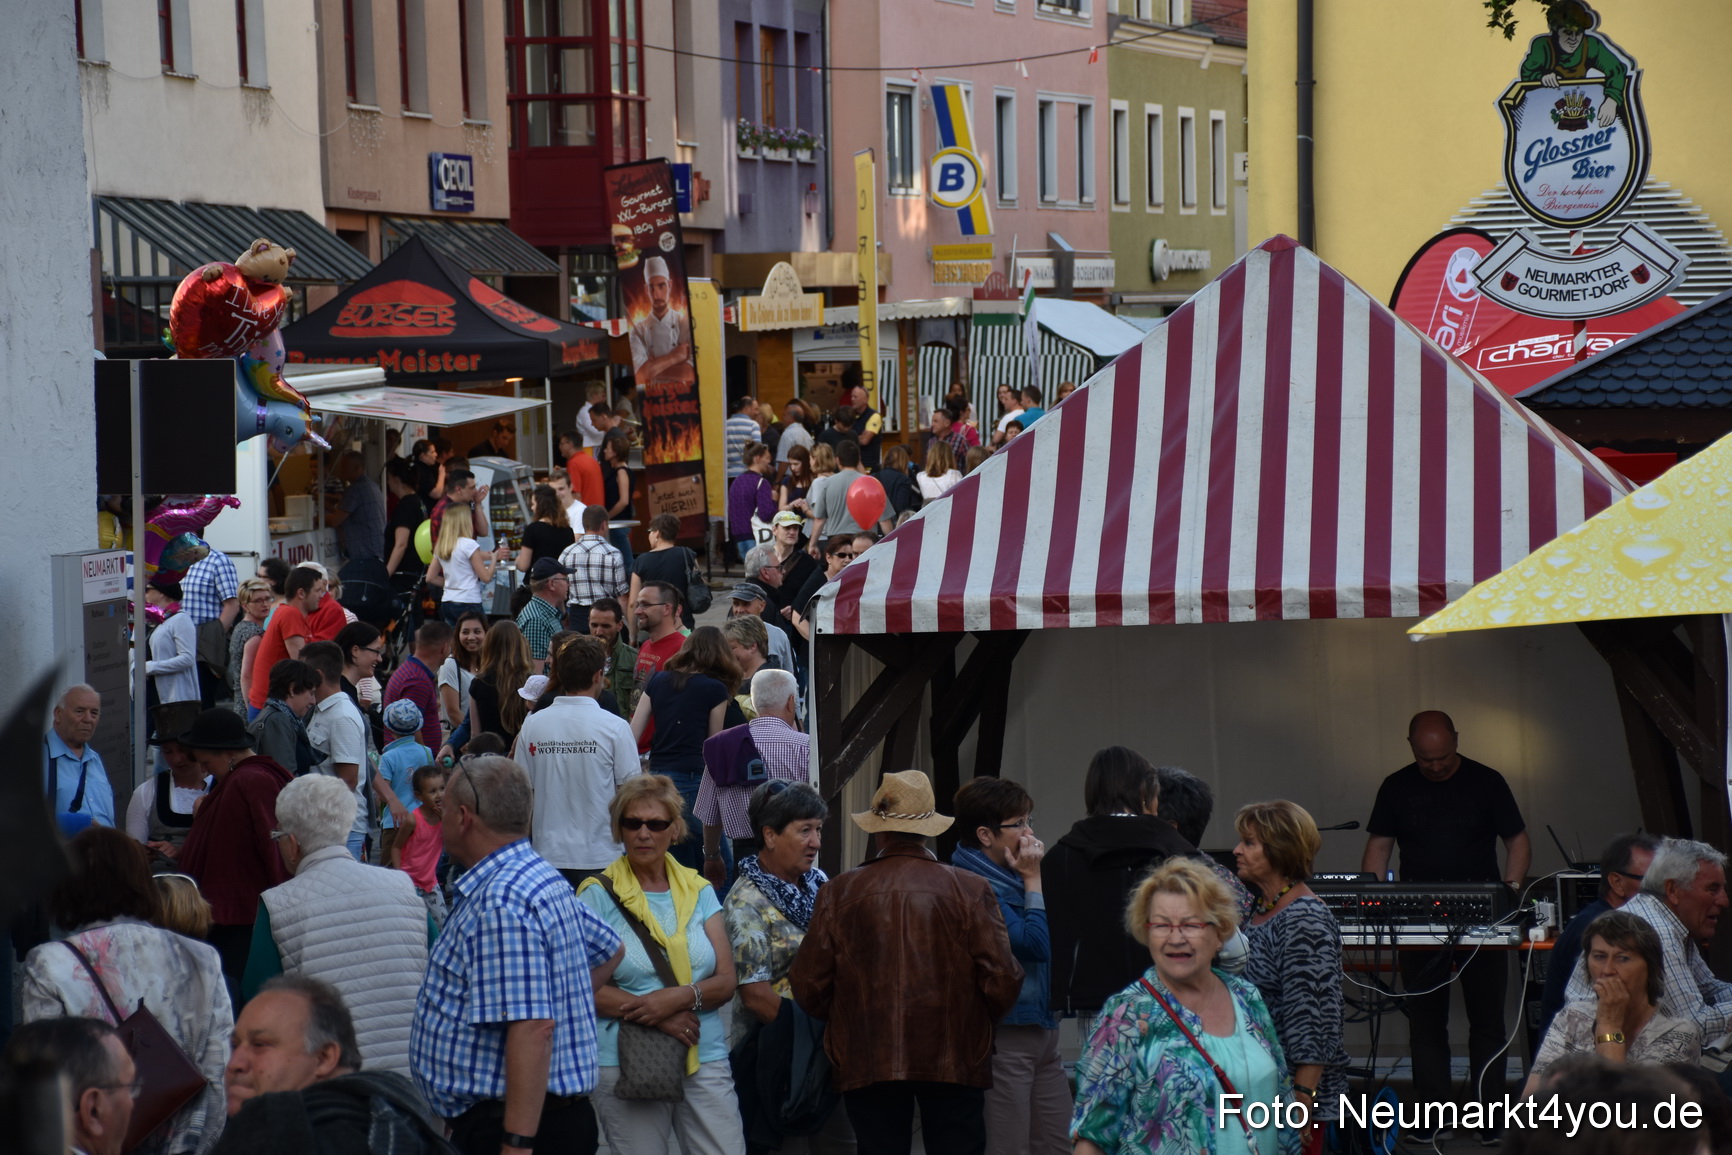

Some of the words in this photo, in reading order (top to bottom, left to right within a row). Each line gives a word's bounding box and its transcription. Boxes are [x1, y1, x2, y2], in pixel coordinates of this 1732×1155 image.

[1523, 126, 1617, 184] Glossner
[440, 157, 474, 192] CECIL
[938, 162, 965, 192] B
[1571, 157, 1616, 180] Bier
[620, 183, 663, 208] Gourmet
[1536, 183, 1558, 197] Der
[616, 196, 674, 224] XXL-Burger
[1542, 197, 1600, 214] Biergenuss
[633, 222, 654, 236] 180g
[1524, 261, 1624, 286] NEUMARKTER
[1517, 275, 1632, 302] GOURMET-DORF
[336, 303, 457, 328] BURGER
[1434, 305, 1463, 350] ari
[1488, 333, 1626, 363] charia
[83, 557, 119, 579] NEUMARKT
[536, 740, 598, 748] Sanitätsbereitschaft
[537, 746, 597, 755] WOFFENBACH
